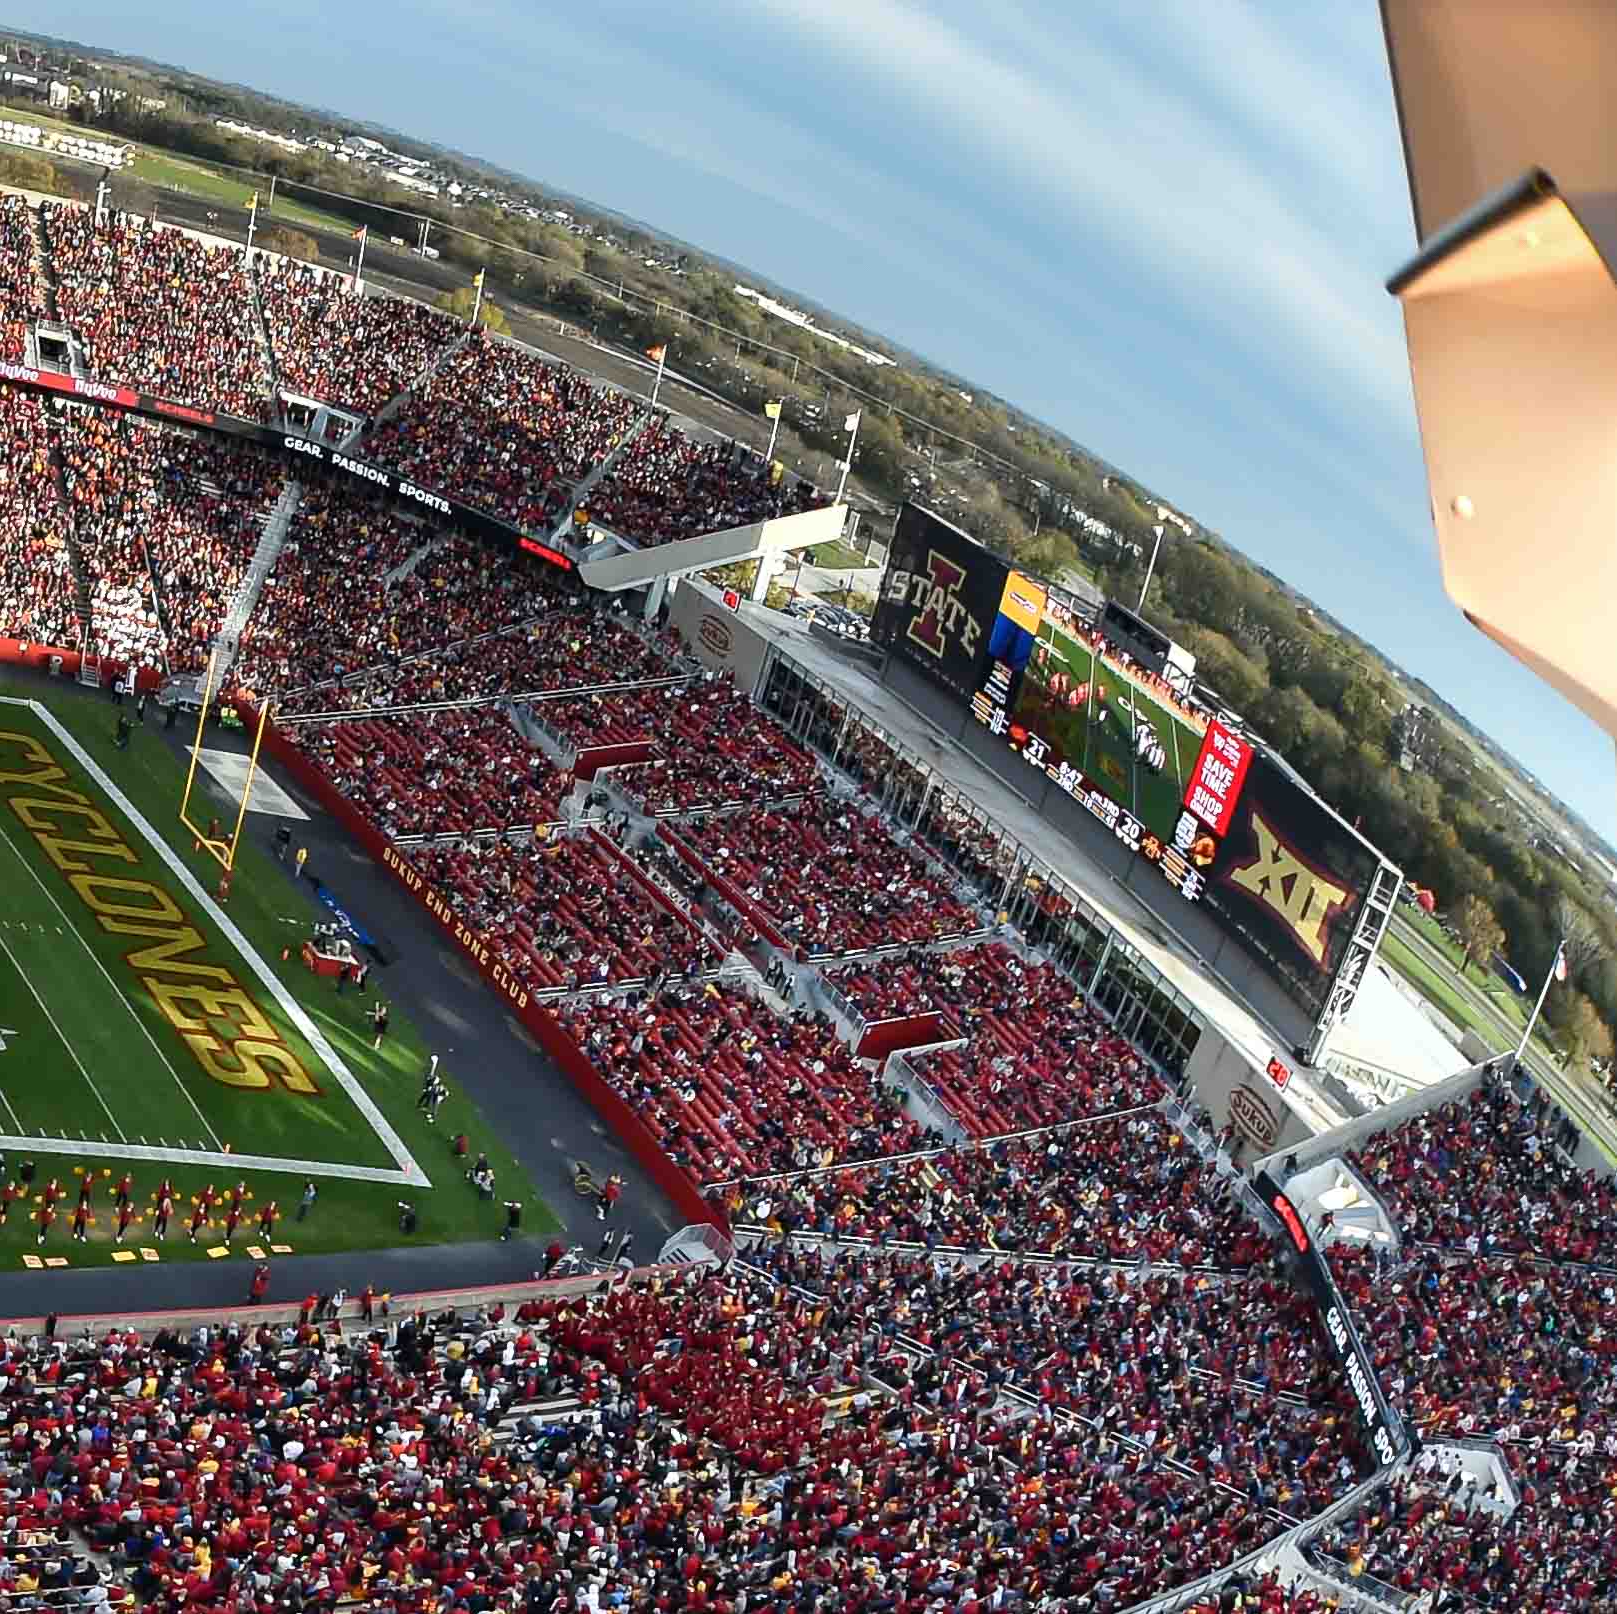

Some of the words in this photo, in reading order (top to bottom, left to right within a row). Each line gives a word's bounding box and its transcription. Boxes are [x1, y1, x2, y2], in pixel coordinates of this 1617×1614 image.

[284, 437, 323, 458] GEAR.
[332, 453, 390, 487] PASSION.
[398, 482, 452, 515] SPORTS.
[888, 570, 981, 659] STATE
[1028, 740, 1044, 759] 21
[1204, 753, 1234, 786] SAVE
[1193, 786, 1223, 815] SHOP
[1201, 768, 1227, 800] TIME.
[1122, 817, 1140, 838] 20
[1231, 812, 1347, 962] XII
[383, 847, 422, 891] SUKUP
[425, 891, 451, 924] END
[454, 922, 489, 965] ZONE
[492, 964, 528, 1008] CLUB
[1327, 1306, 1347, 1353] GEAR.
[1345, 1352, 1377, 1426] PASSION.
